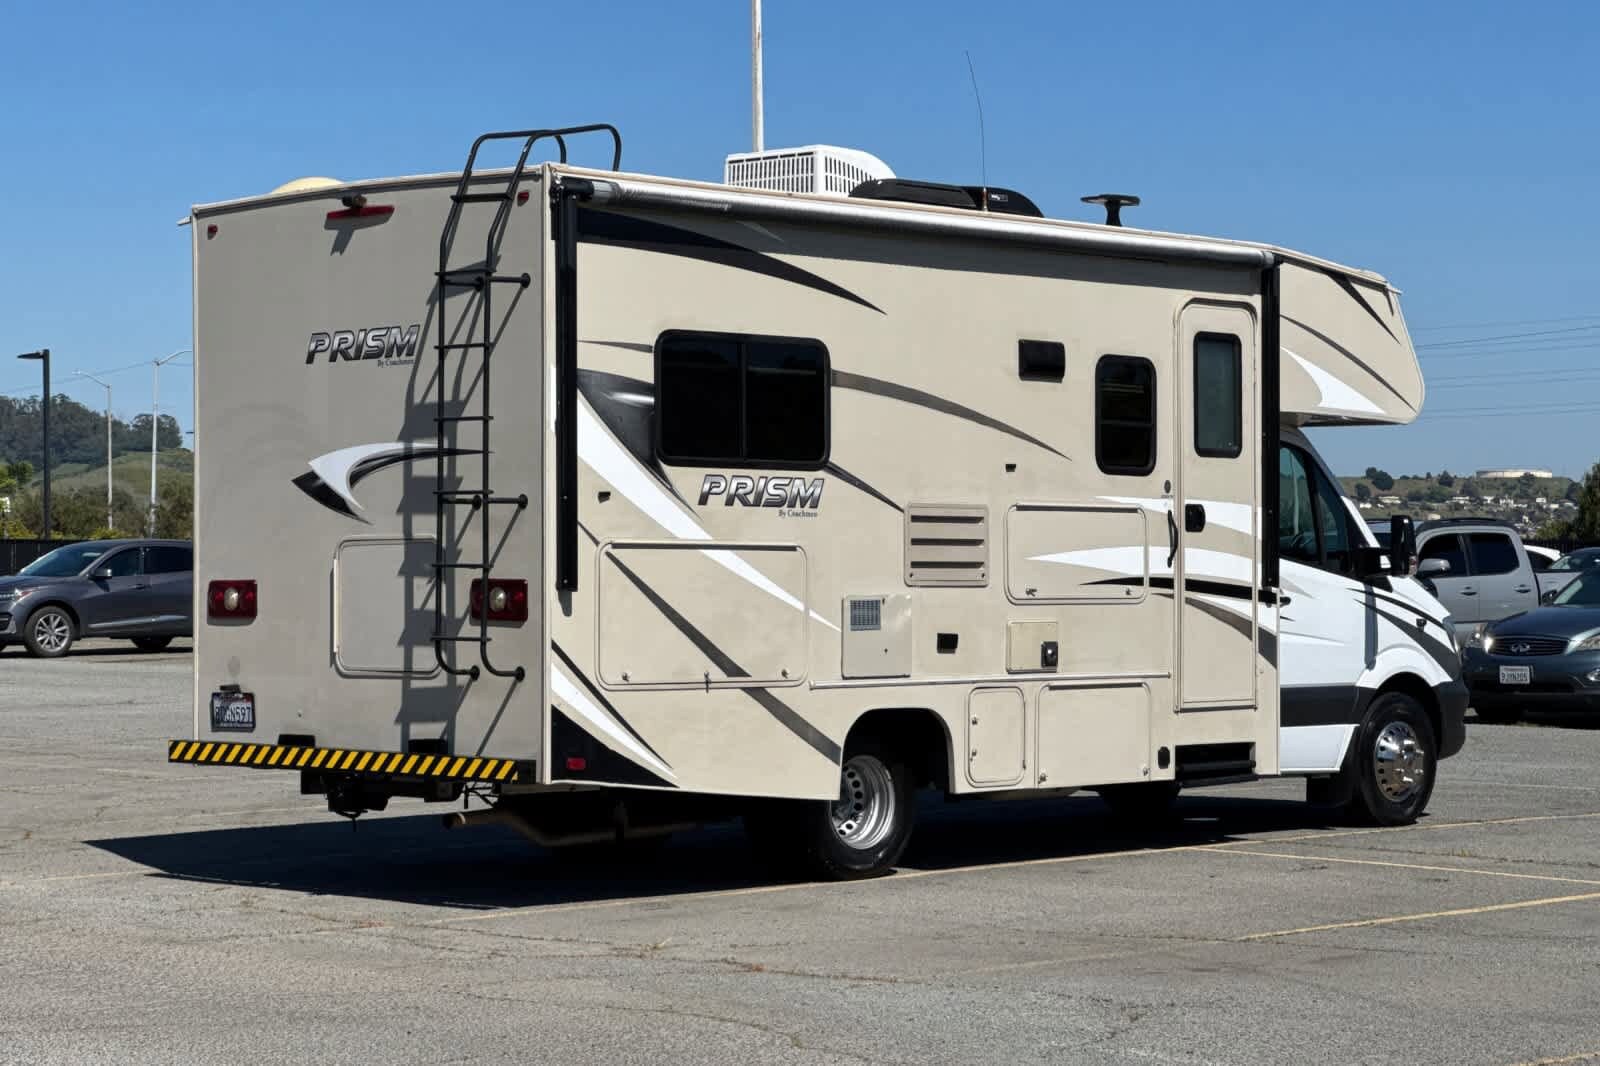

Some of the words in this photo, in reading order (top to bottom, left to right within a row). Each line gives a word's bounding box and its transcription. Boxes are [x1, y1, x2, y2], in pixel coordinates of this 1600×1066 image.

[305, 324, 420, 364] PRISM
[698, 474, 825, 508] PRISM
[778, 509, 786, 519] By
